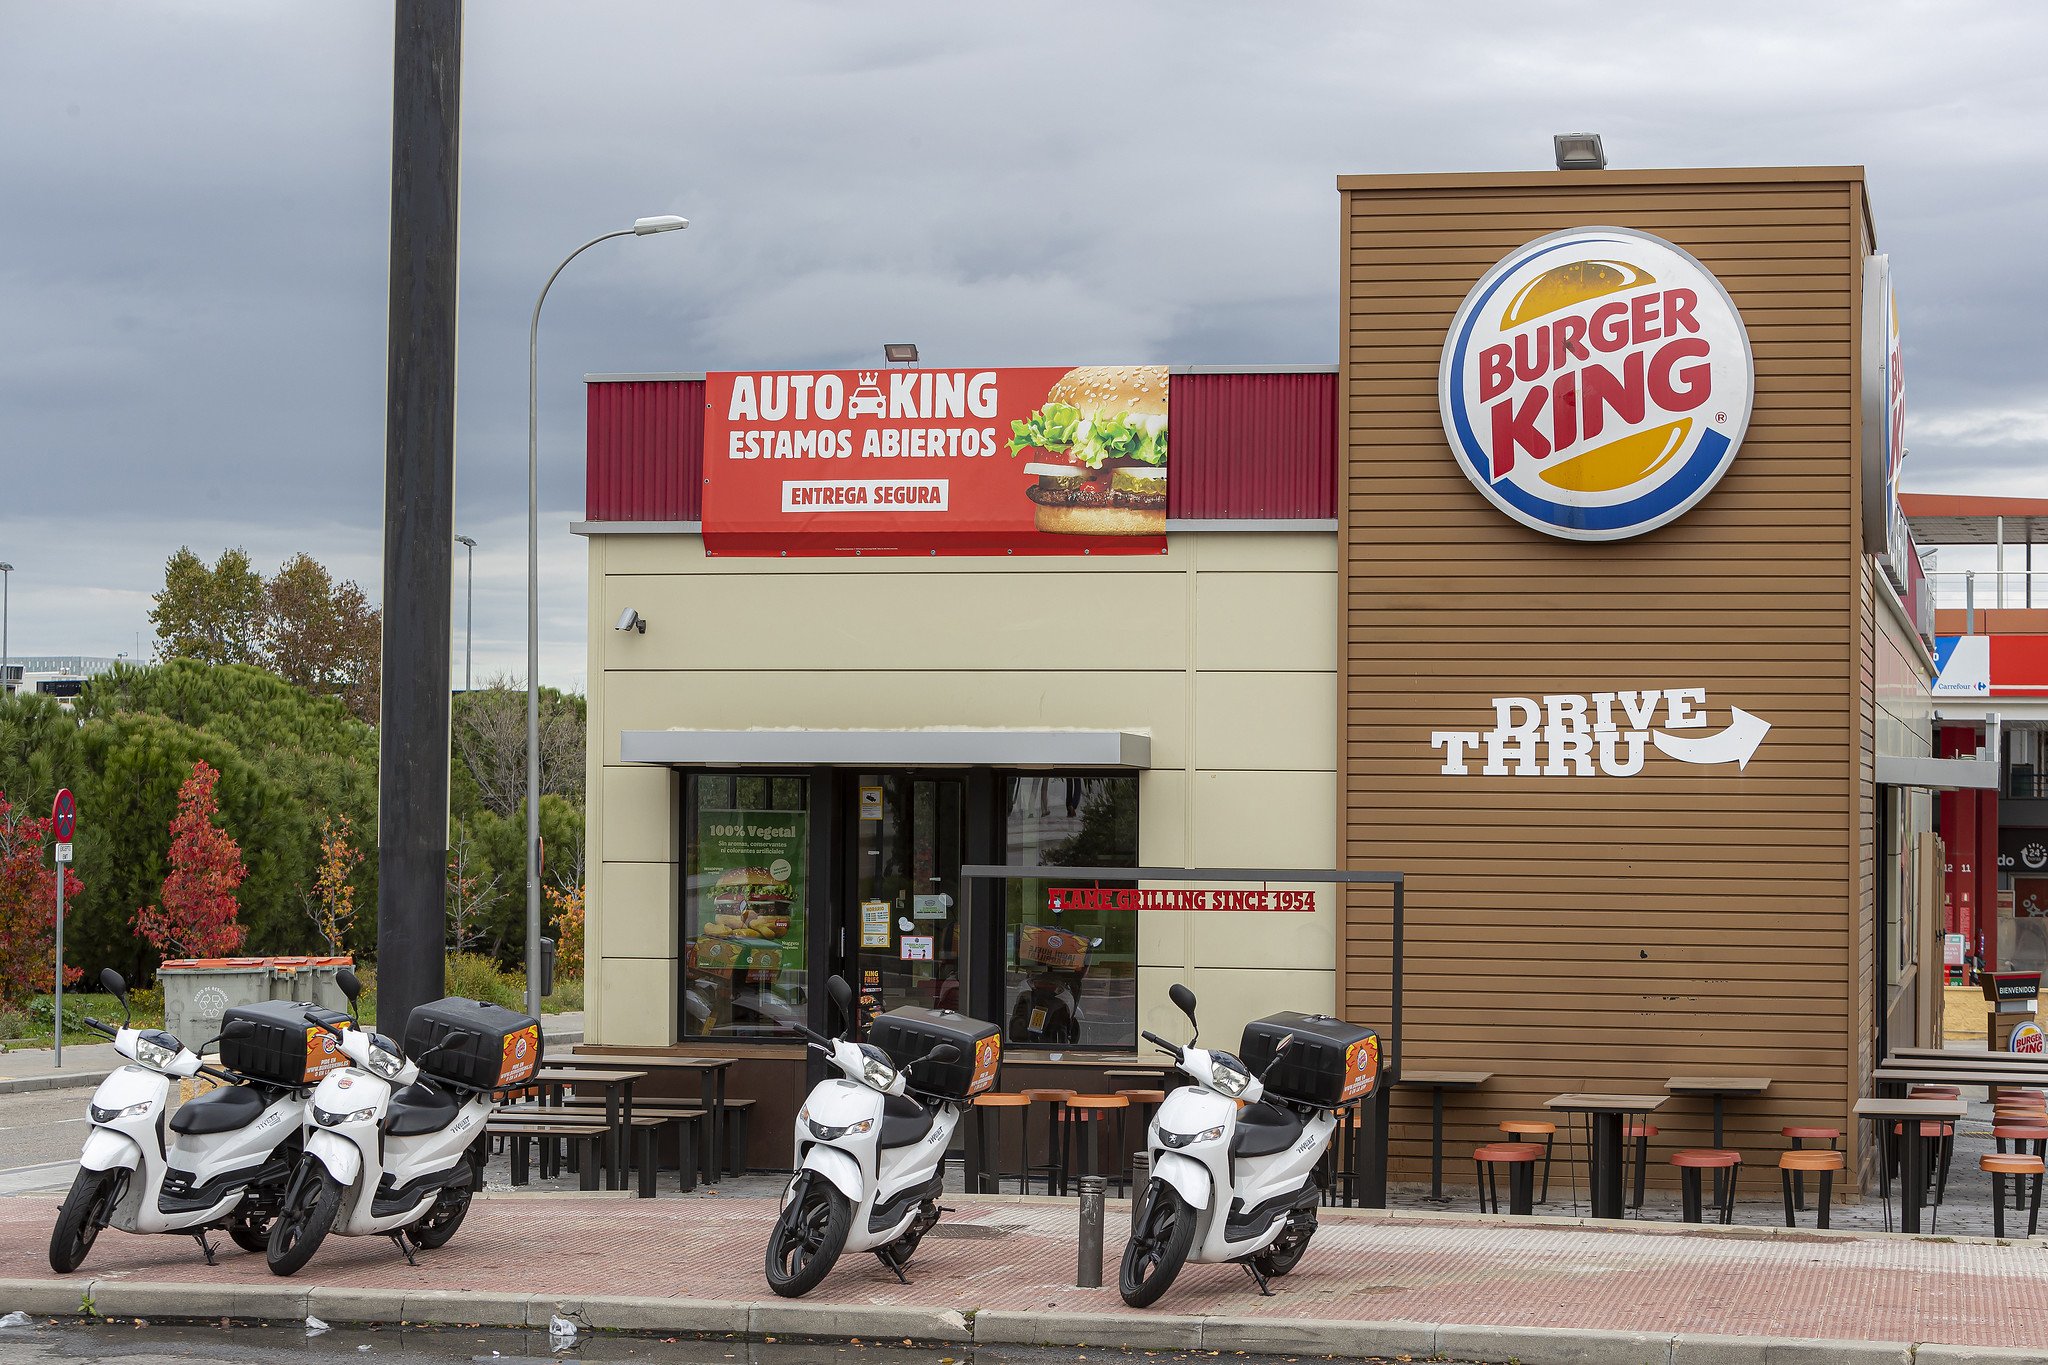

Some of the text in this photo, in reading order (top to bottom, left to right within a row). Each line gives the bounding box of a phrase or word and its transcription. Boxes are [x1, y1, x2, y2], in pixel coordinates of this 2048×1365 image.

[1479, 288, 1700, 404] BURGER
[728, 372, 998, 421] AUTO KING
[1491, 338, 1711, 479] KING
[729, 428, 997, 459] ESTAMOS ABIERTOS
[791, 486, 941, 505] ENTREGA SEGURA
[1492, 688, 1707, 734] DRIVE
[1431, 727, 1649, 777] THRU
[709, 825, 796, 840] 100% Vegetal
[2029, 848, 2041, 857] 24
[1961, 864, 1971, 873] 11
[1048, 888, 1316, 912] FLAME GRILLING SINCE 1954
[864, 976, 879, 984] FRIES
[2000, 986, 2036, 994] BIENVENIDOS
[2016, 1033, 2042, 1048] BURGER
